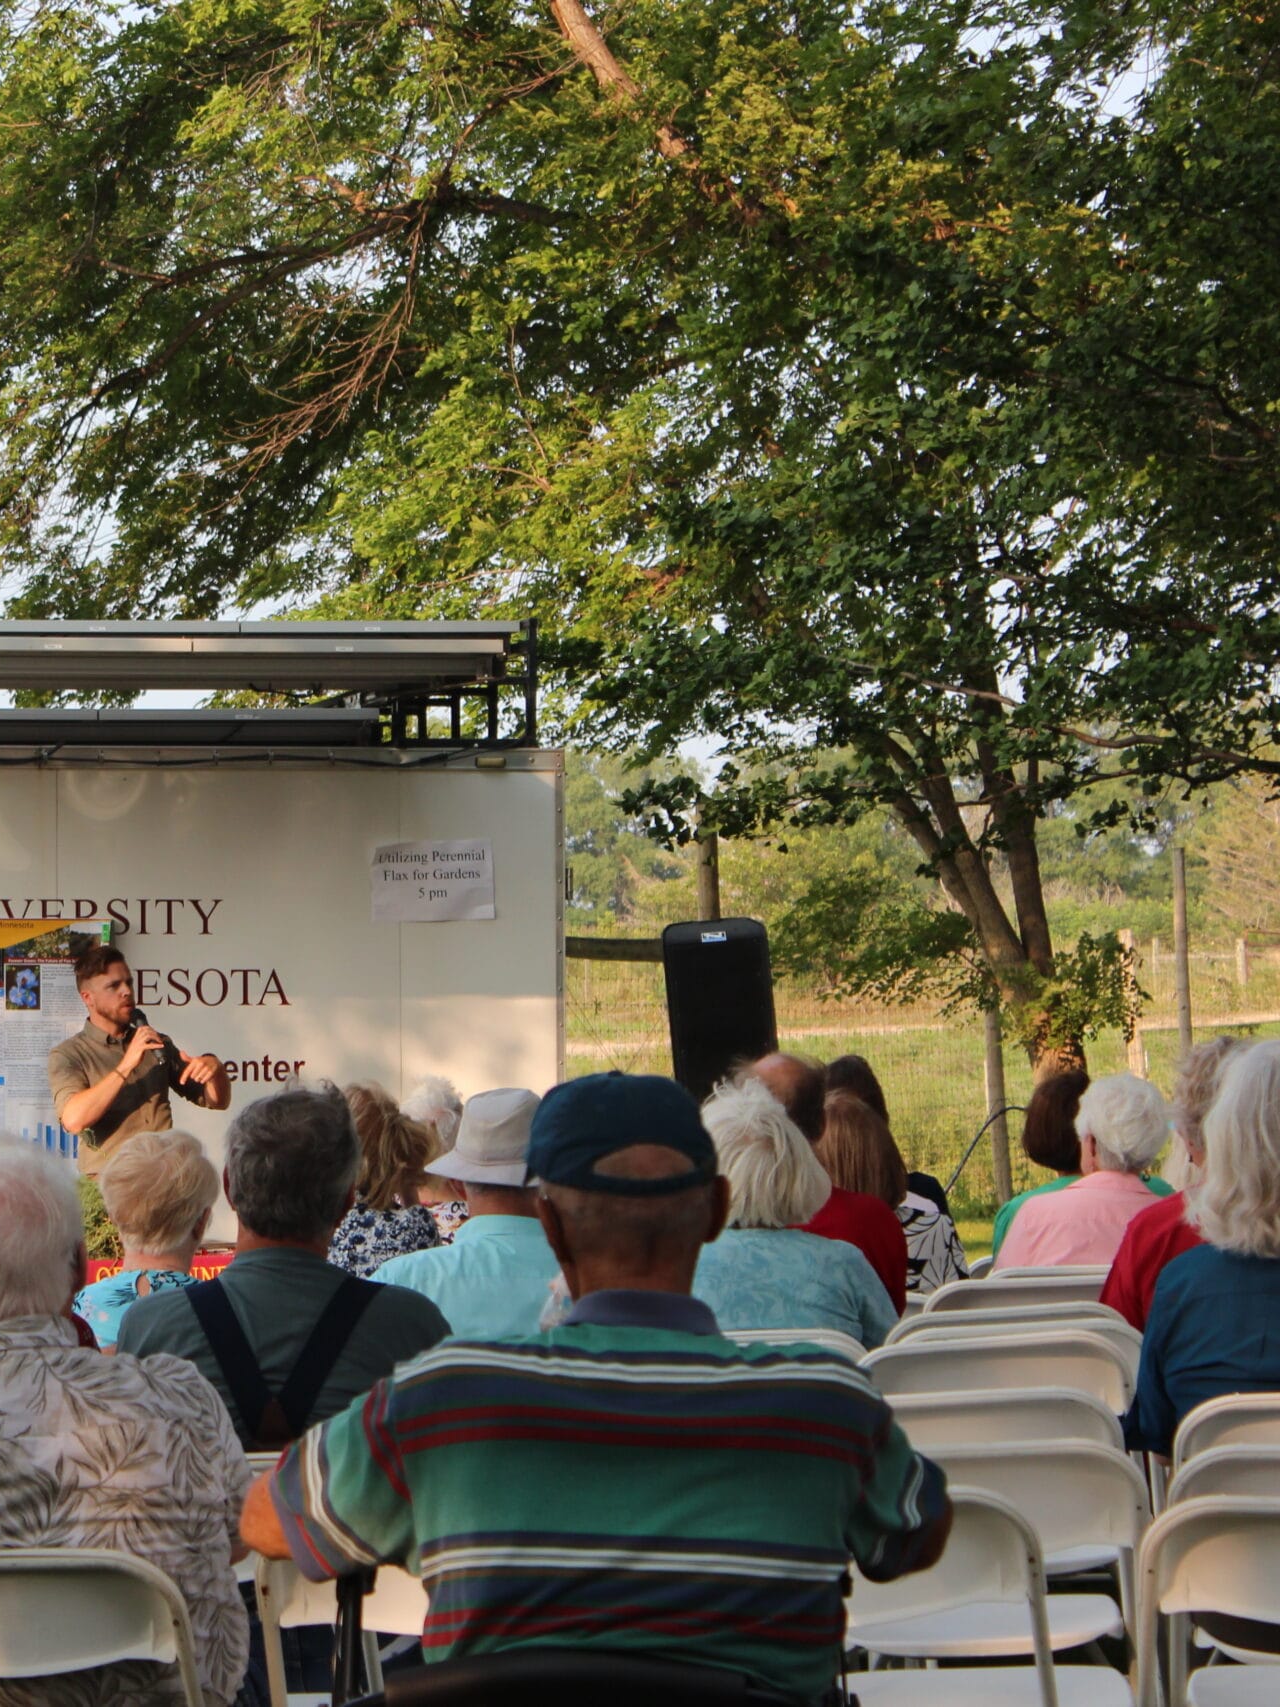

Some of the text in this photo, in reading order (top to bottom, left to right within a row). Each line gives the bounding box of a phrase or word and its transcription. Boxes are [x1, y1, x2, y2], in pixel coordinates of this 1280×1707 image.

[379, 849, 485, 865] Utilizing Perennial
[383, 868, 481, 881] Flax for Gardens
[418, 887, 448, 901] 5 pm
[134, 968, 293, 1007] ESOTA
[223, 1053, 306, 1082] enter
